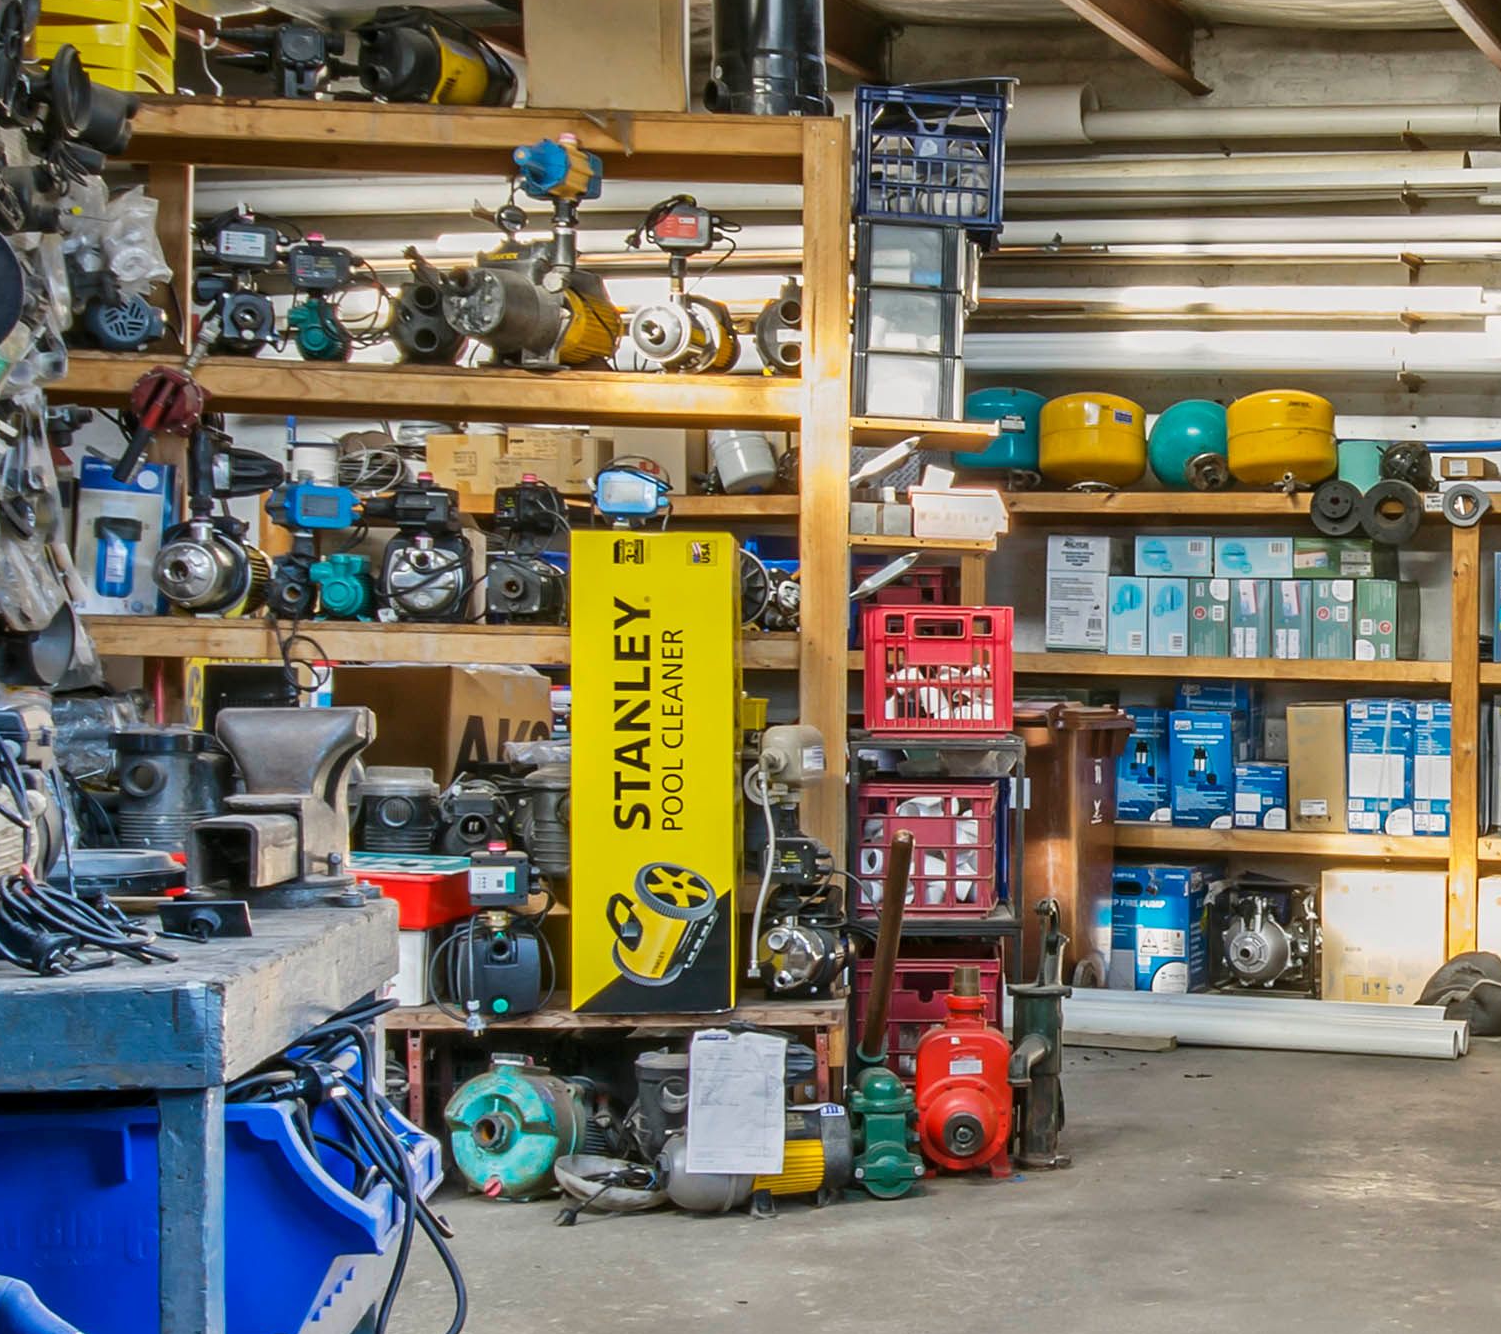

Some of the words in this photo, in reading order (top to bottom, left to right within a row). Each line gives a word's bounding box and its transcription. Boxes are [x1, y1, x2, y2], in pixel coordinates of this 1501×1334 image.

[700, 542, 711, 565] USA
[613, 596, 651, 830] STANLEY
[662, 629, 684, 749] CLEANER
[662, 758, 684, 831] POOL
